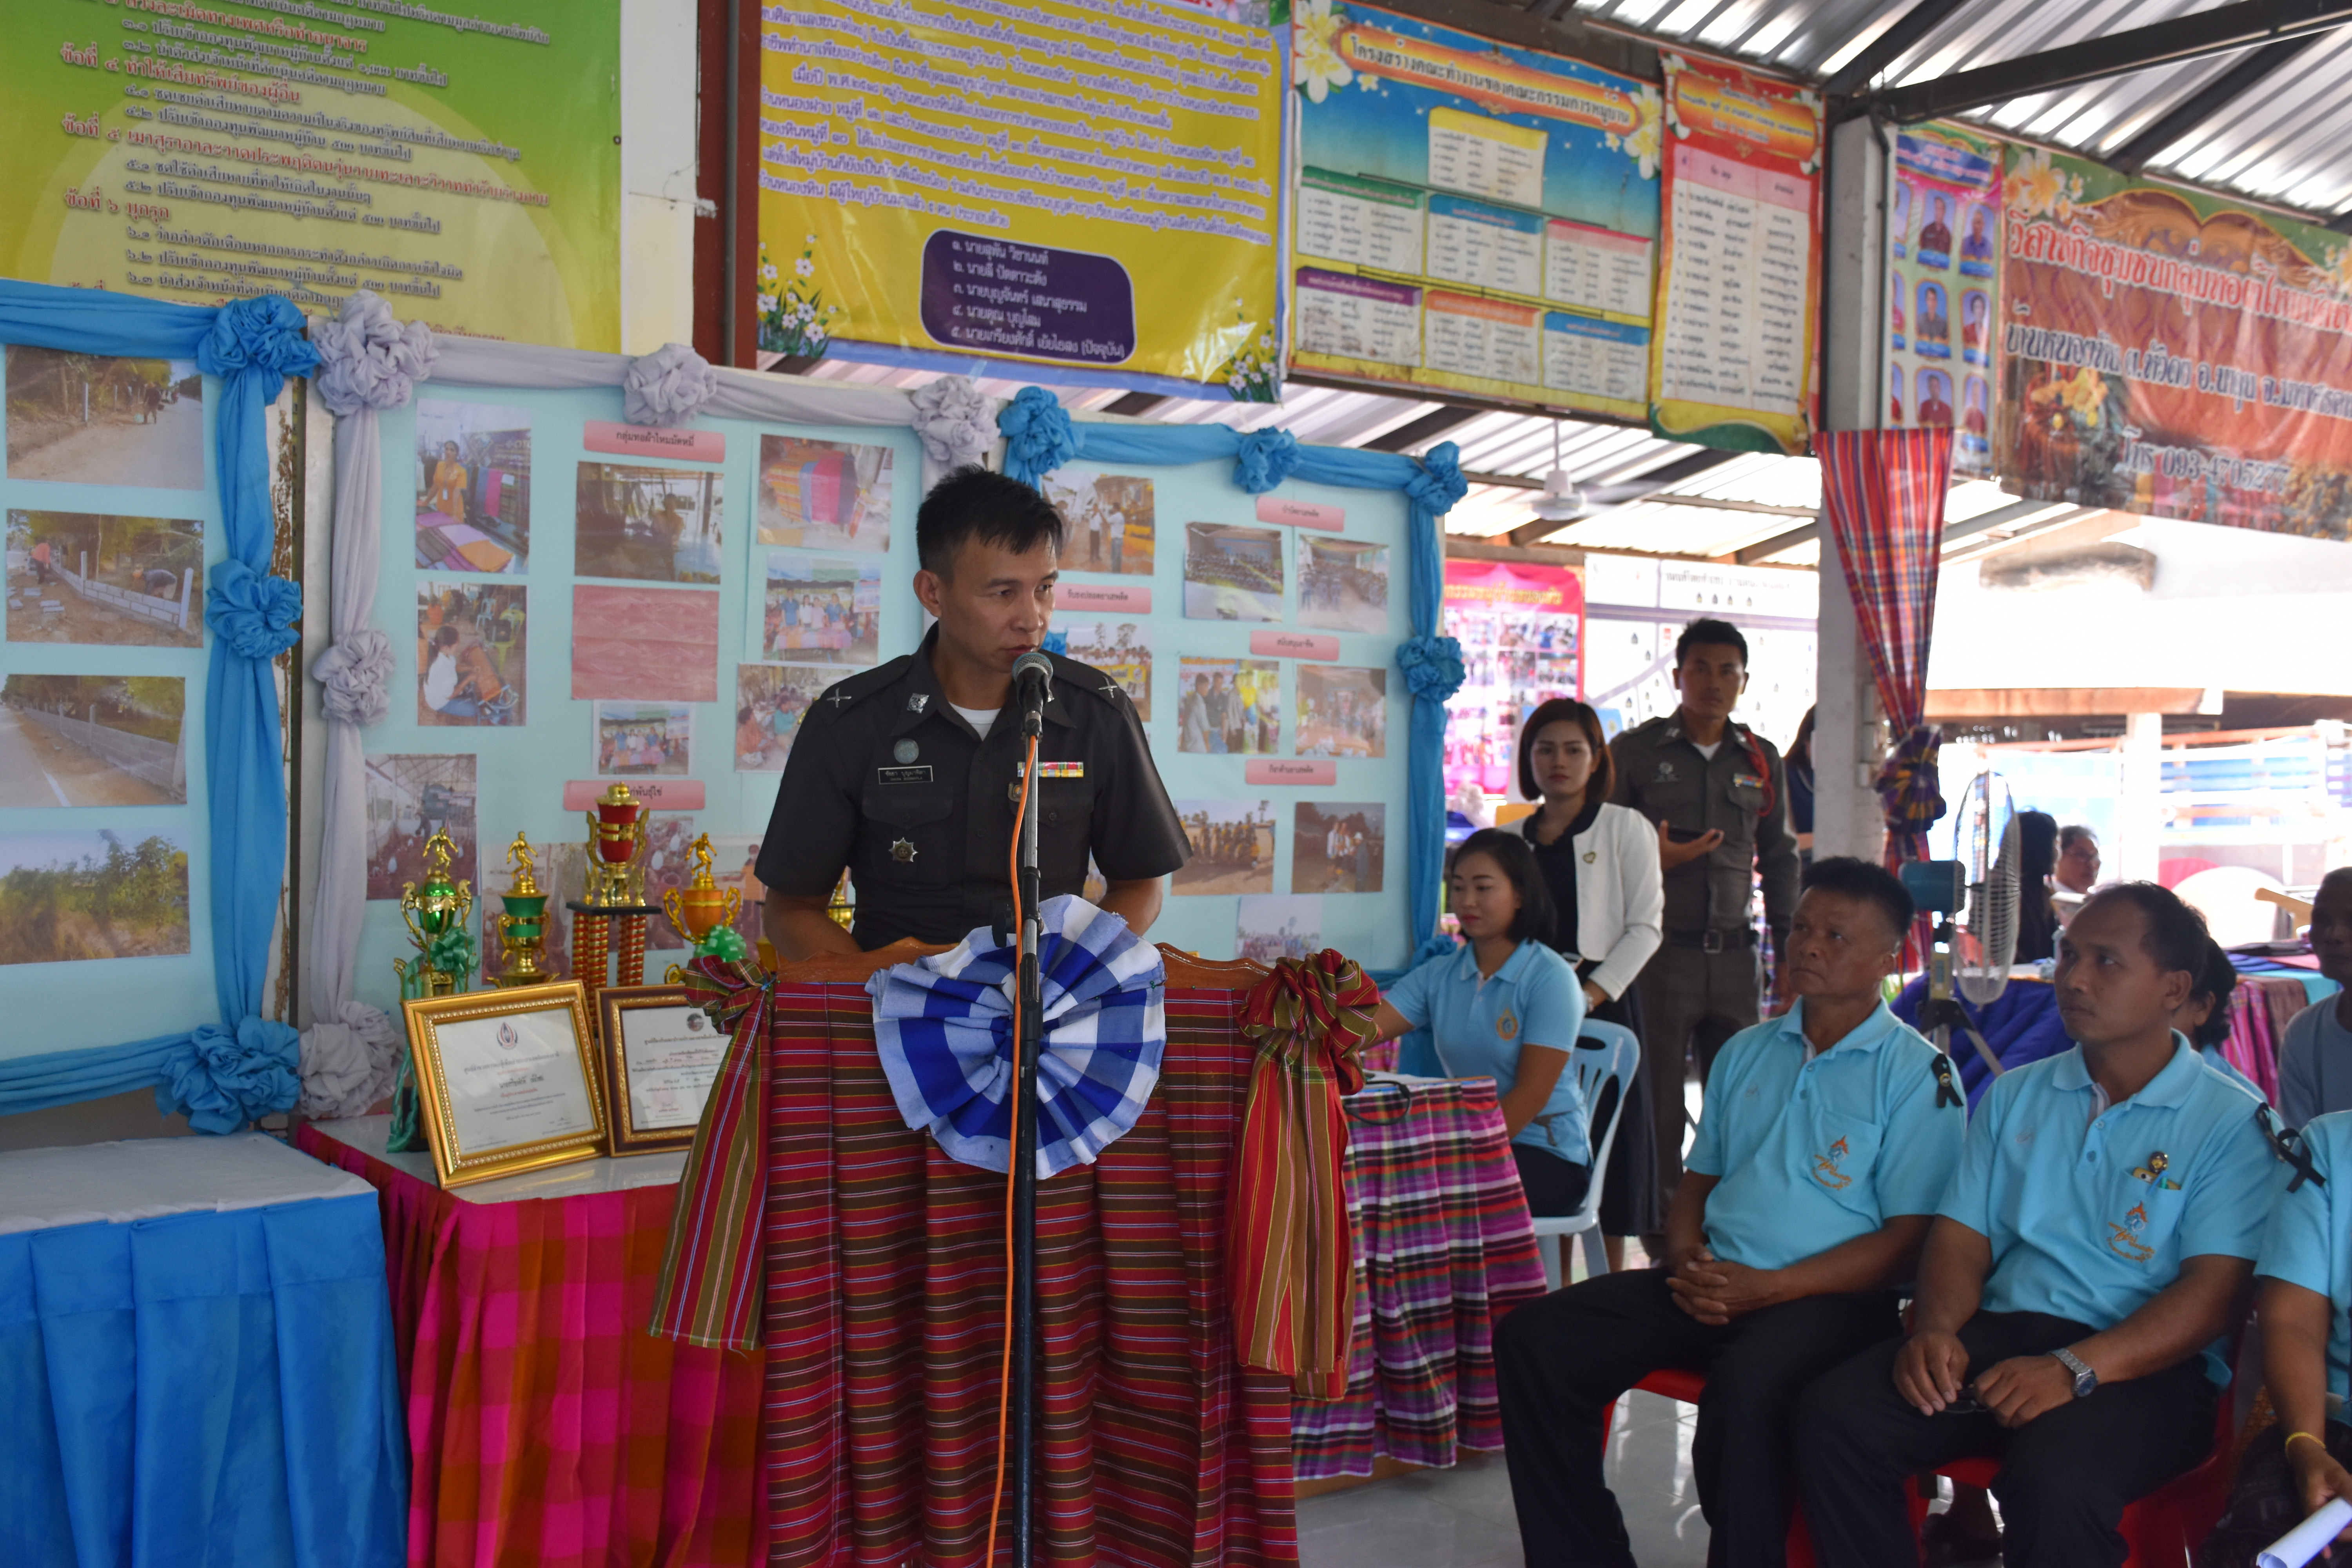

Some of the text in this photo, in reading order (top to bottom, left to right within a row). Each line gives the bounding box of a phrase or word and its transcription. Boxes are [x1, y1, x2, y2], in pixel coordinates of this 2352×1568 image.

[61, 42, 98, 67] ข้อที่
[125, 55, 300, 106] ทำให้เสียทรัพย์ของผู้อื่น
[792, 62, 824, 86] เมื่อปี
[835, 97, 864, 123] หมู่ที่
[62, 112, 100, 137] ข้อที่
[759, 168, 826, 198] ้านหนองหิน
[65, 186, 102, 210] ข้อที่
[127, 202, 170, 223] บุกรุก
[388, 211, 441, 234] บาทขึ้นไป
[389, 276, 441, 299] บาทขึ้นไป
[2123, 425, 2155, 474] โทร
